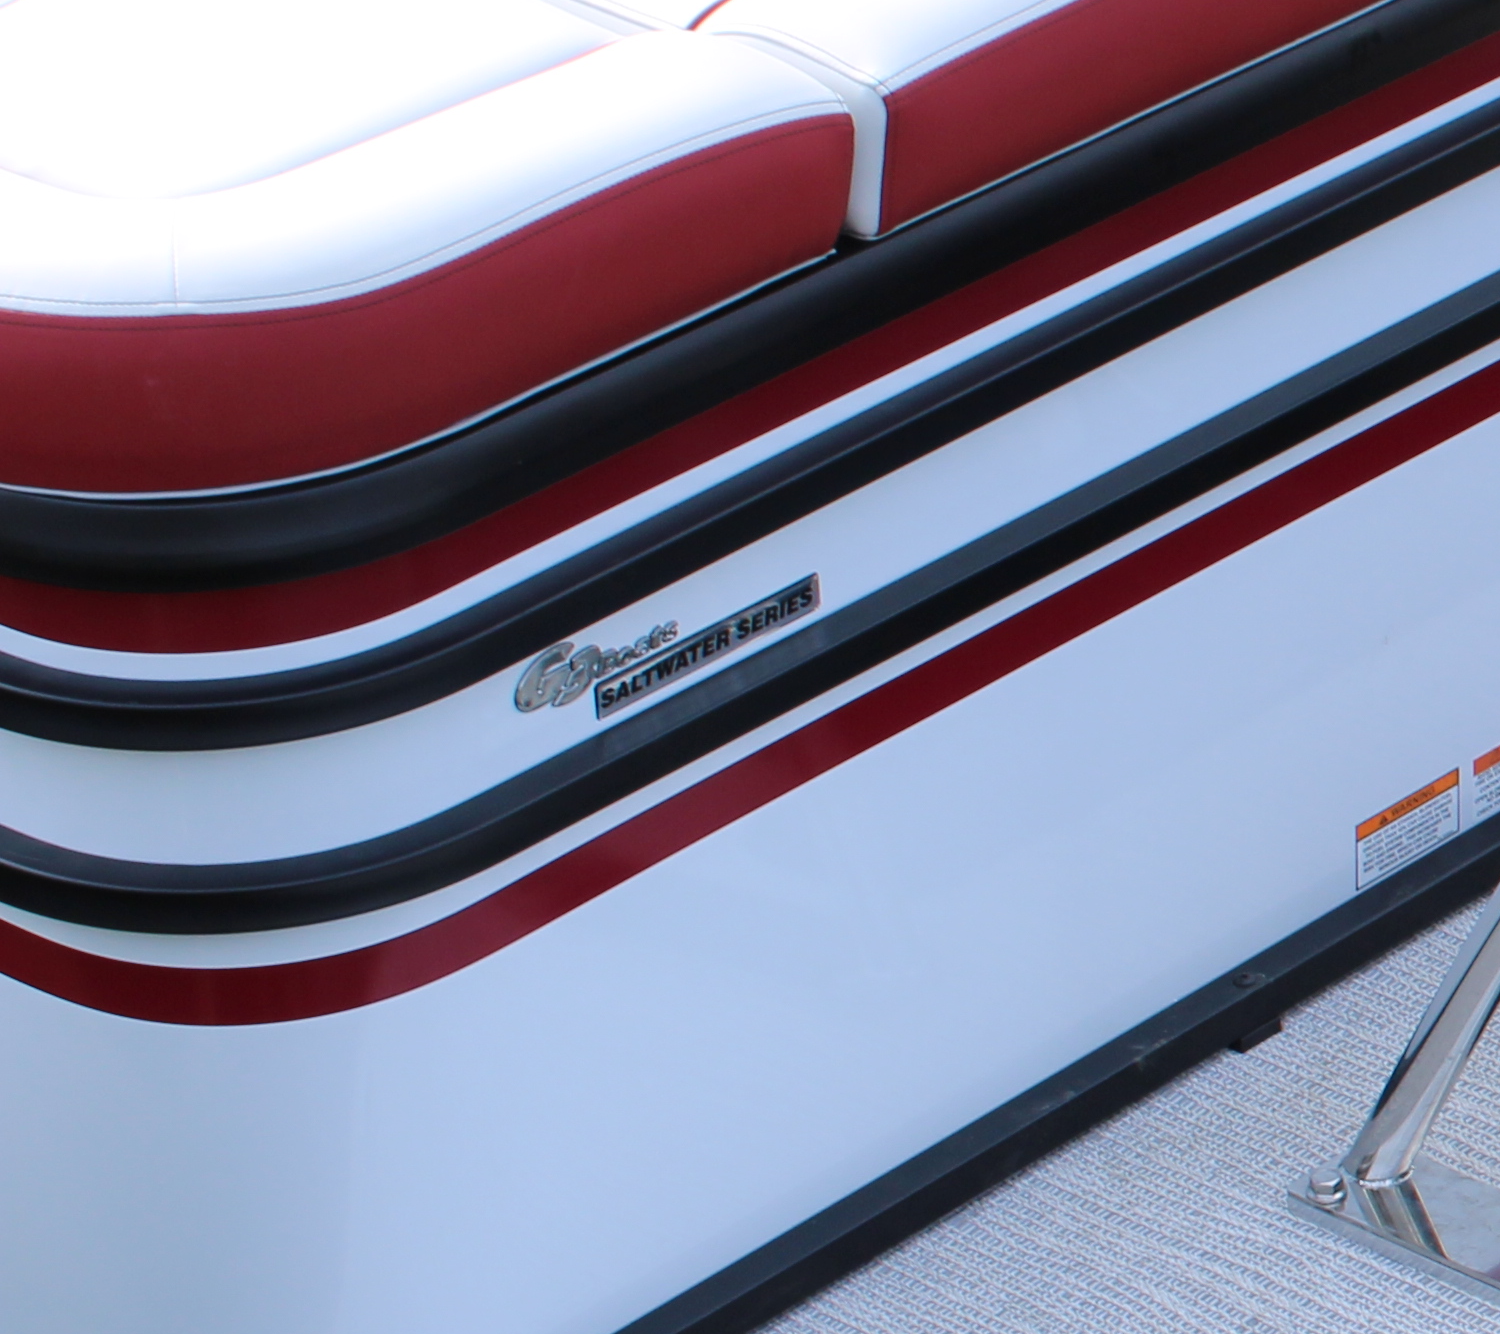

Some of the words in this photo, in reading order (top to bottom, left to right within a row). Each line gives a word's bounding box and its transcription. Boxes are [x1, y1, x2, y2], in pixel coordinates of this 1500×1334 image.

[601, 624, 731, 708] SALTWATER
[736, 585, 813, 639] SERIES
[1391, 785, 1435, 817] WARNING
